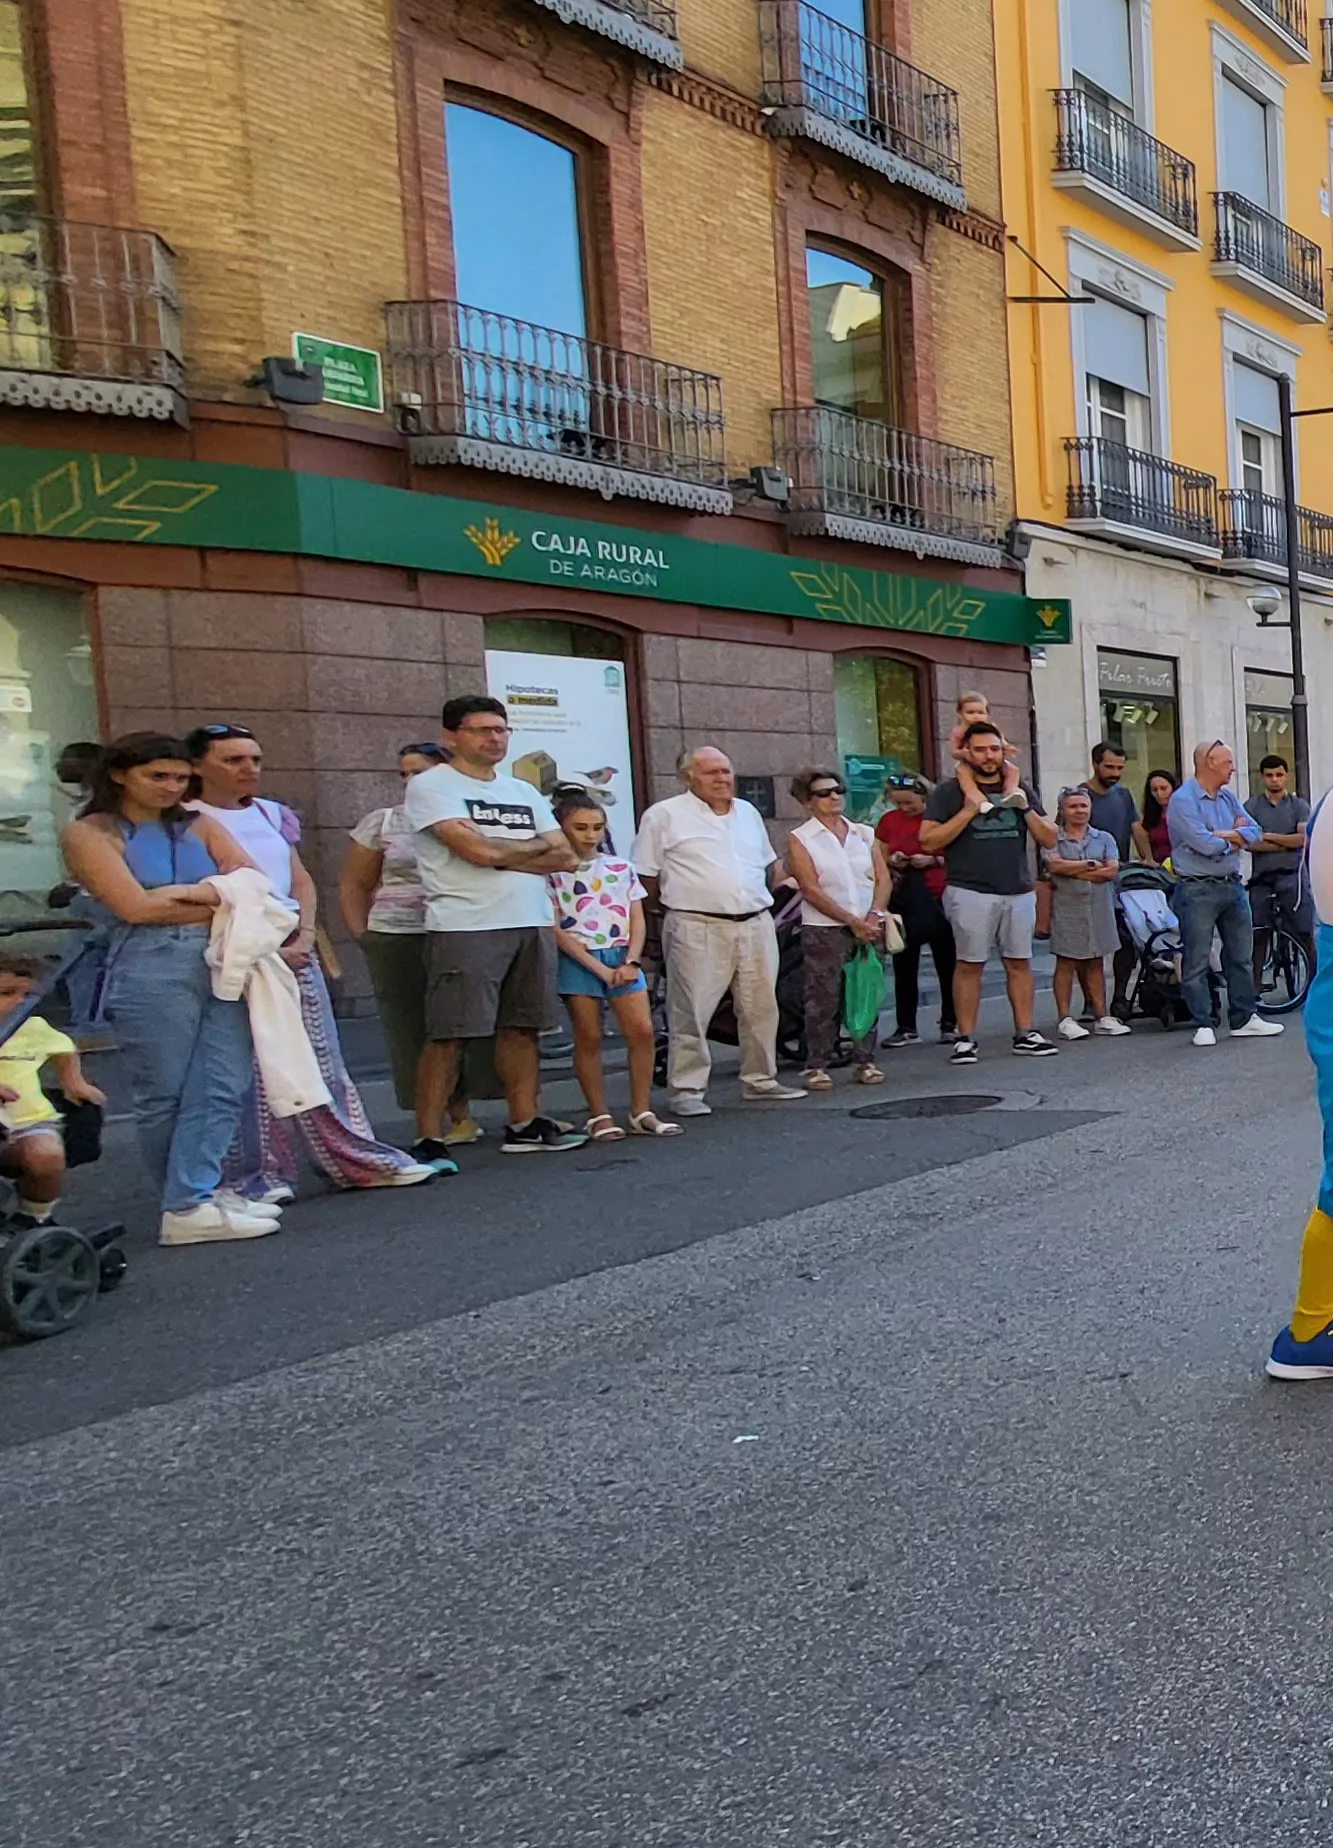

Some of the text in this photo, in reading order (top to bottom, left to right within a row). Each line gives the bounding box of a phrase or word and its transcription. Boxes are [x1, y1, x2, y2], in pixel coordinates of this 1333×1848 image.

[531, 530, 670, 569] CAJA RURAL
[550, 559, 658, 587] DE ARAGÓN
[506, 684, 559, 695] Hipotecas
